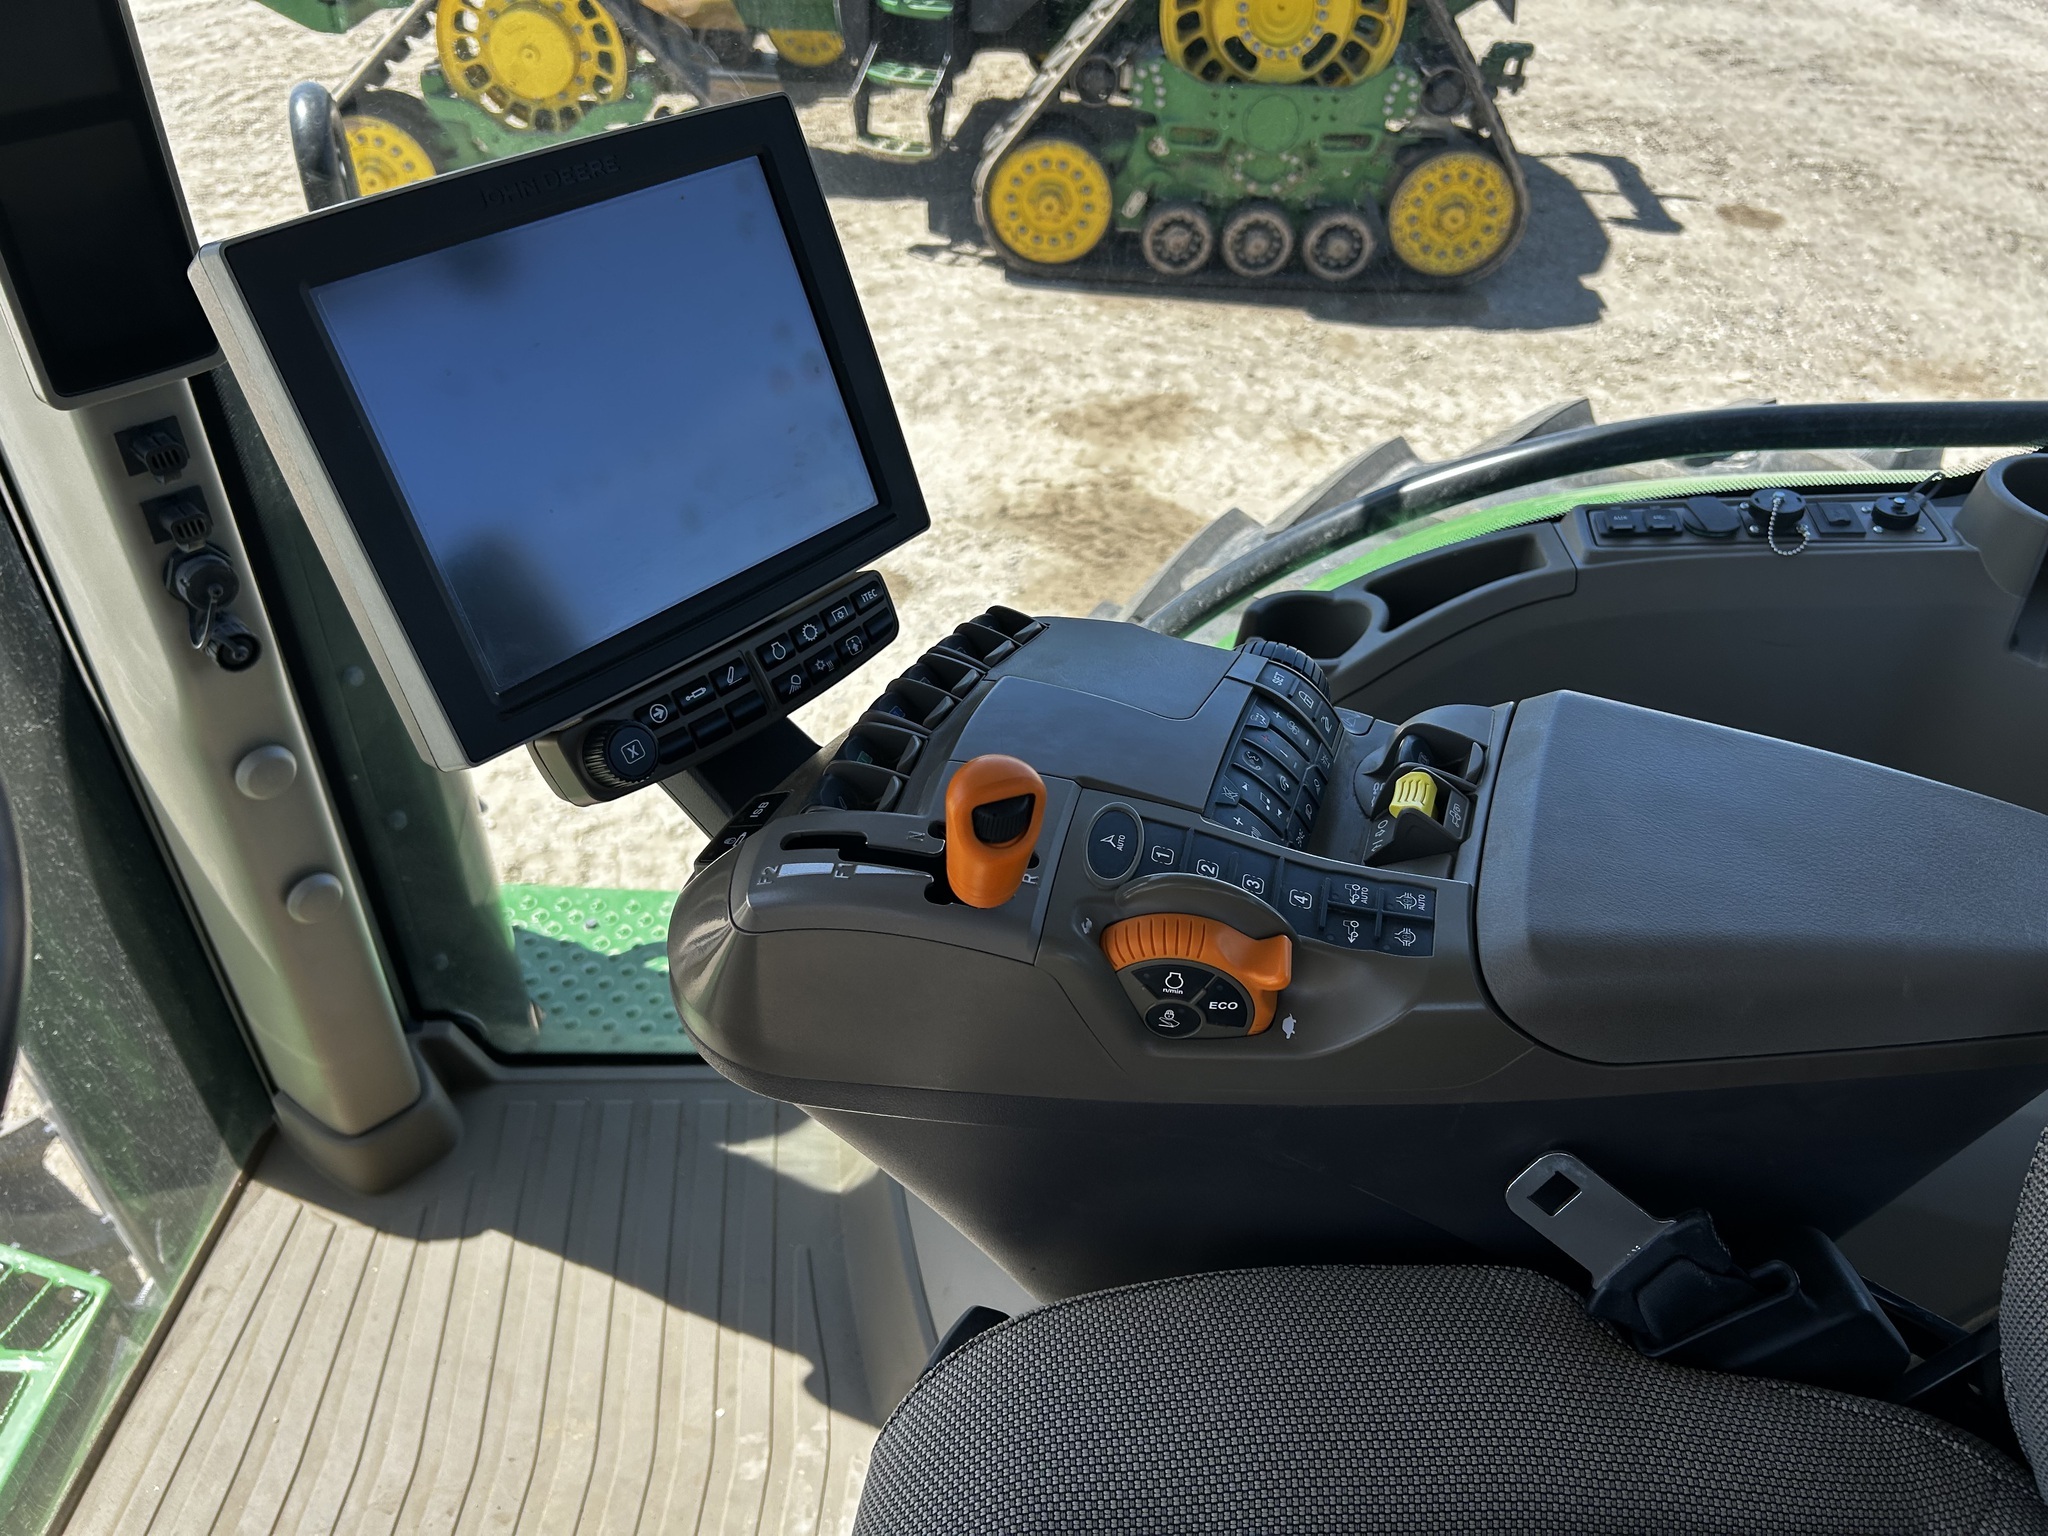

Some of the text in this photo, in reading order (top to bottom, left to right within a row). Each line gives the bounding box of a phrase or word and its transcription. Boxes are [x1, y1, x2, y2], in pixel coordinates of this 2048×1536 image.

[480, 154, 621, 208] JOHN DEERE
[860, 588, 878, 603] iTEC
[1272, 671, 1285, 686] SET
[906, 830, 926, 842] N
[1116, 834, 1126, 852] AUTO
[1156, 851, 1170, 860] 1
[756, 865, 779, 886] F2
[834, 863, 854, 879] F1
[1200, 863, 1216, 875] 2
[1021, 872, 1040, 885] R
[1246, 879, 1260, 889] 3
[1293, 892, 1309, 905] 4
[1360, 886, 1369, 905] AUTO
[1417, 893, 1426, 912] AUTO
[1208, 1001, 1239, 1010] ECO
